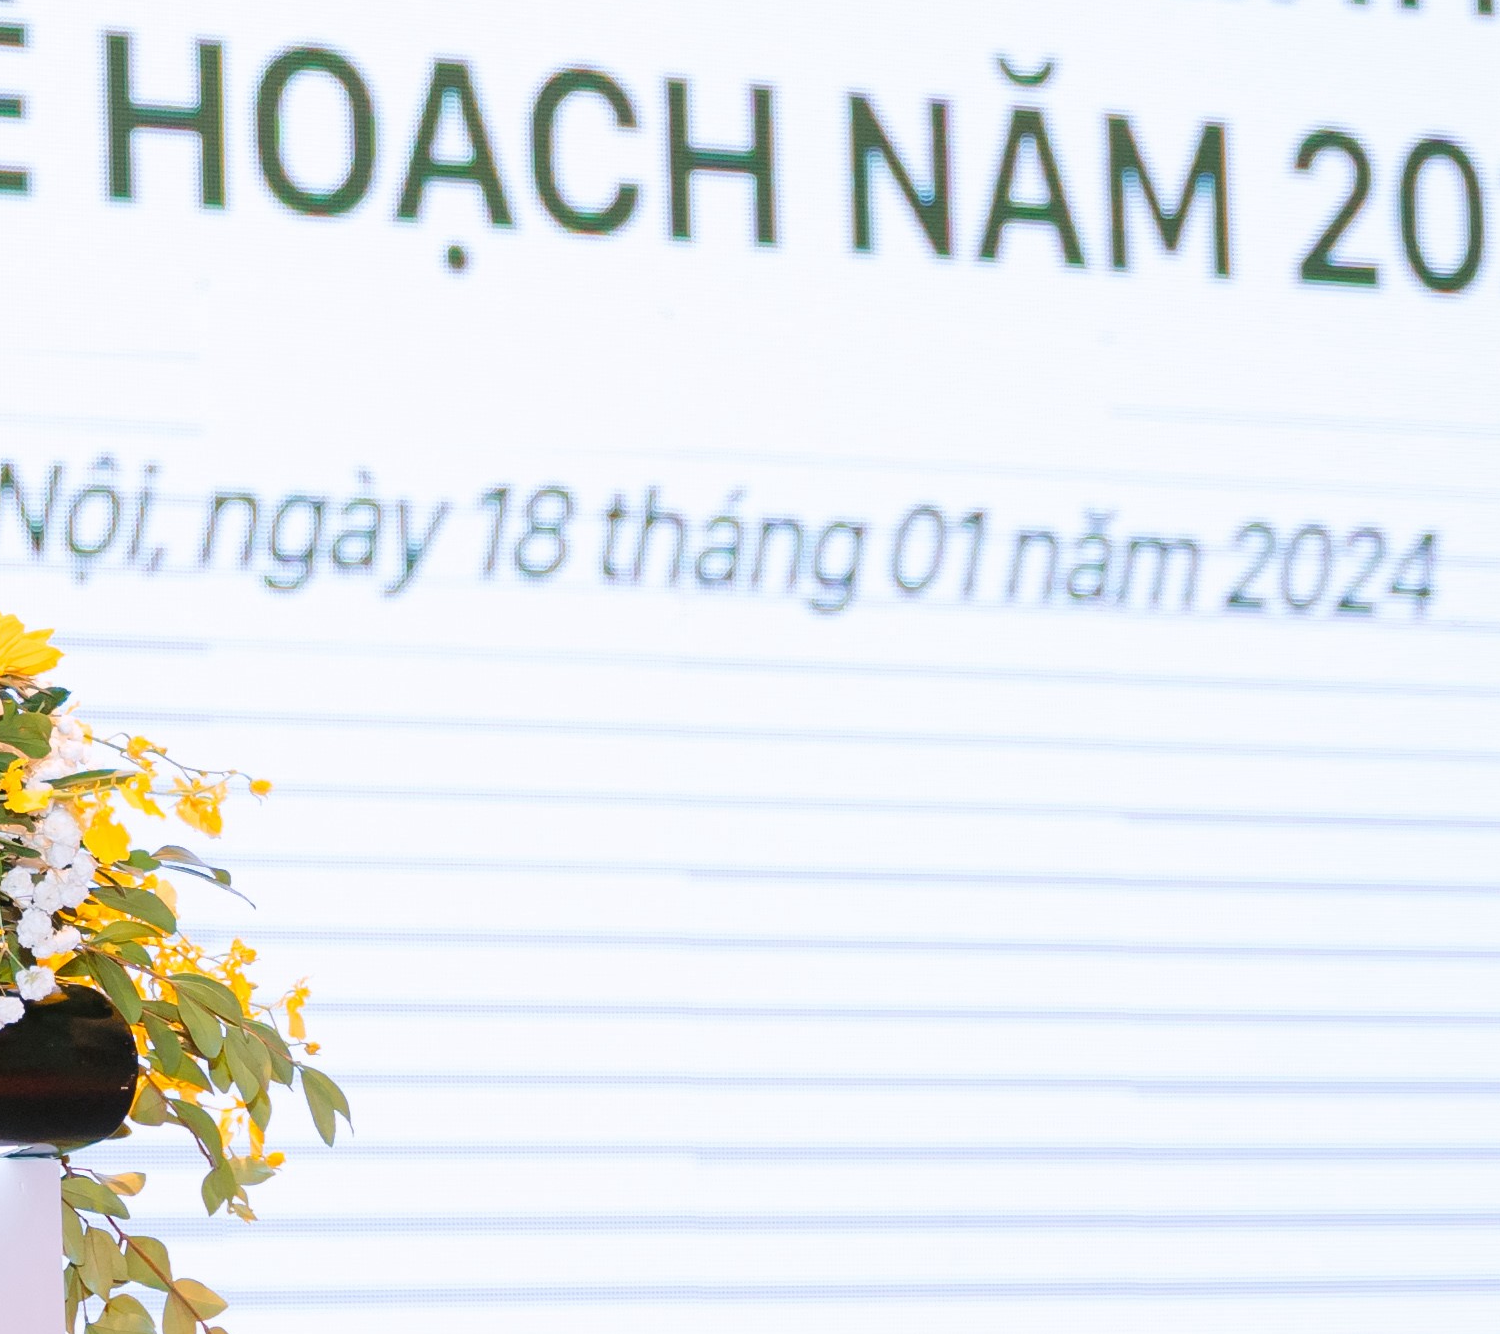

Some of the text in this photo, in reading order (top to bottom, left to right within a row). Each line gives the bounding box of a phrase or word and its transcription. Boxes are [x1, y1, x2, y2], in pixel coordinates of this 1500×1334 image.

[105, 32, 777, 271] HOẠCH
[848, 57, 1231, 278] NĂM
[198, 467, 450, 599] ngày
[480, 484, 576, 583] 18
[599, 485, 869, 617] tháng
[890, 504, 988, 599] 01
[1005, 509, 1203, 607] năm
[1222, 520, 1440, 619] 2024
